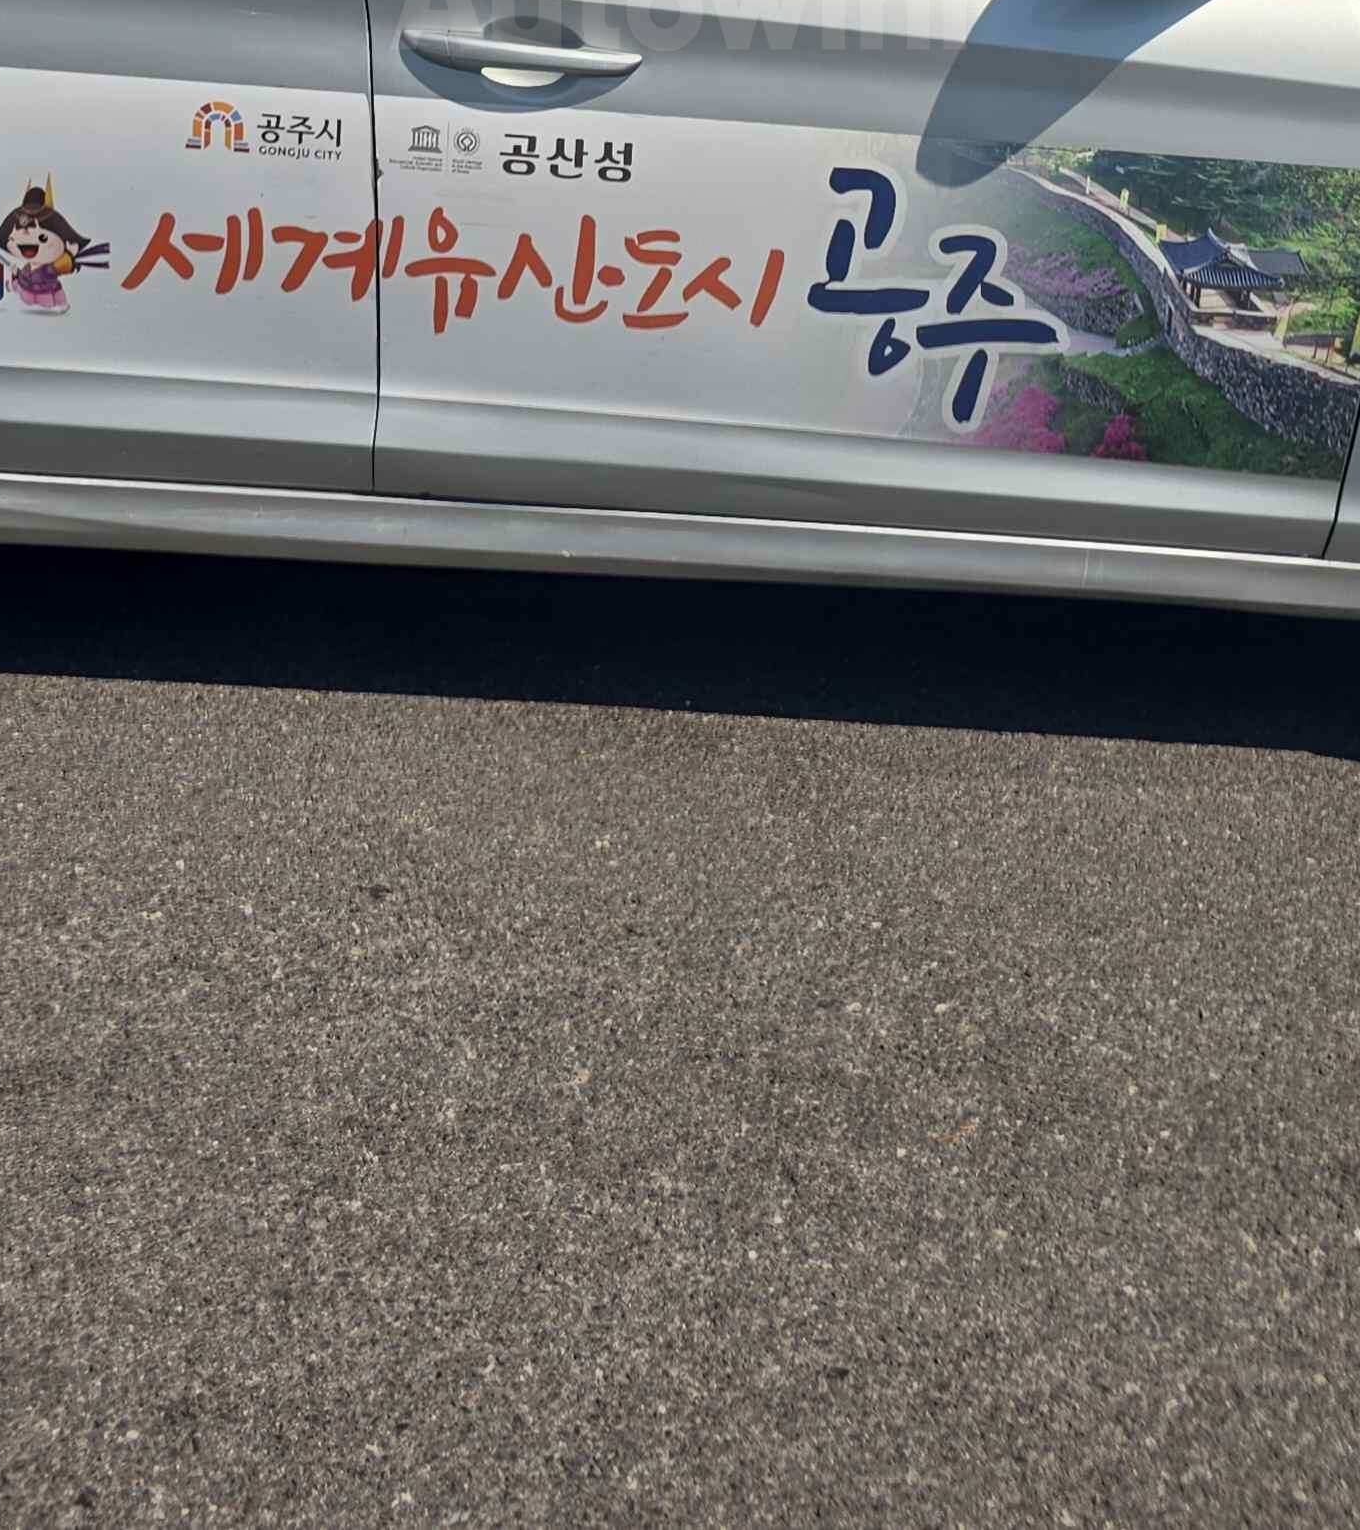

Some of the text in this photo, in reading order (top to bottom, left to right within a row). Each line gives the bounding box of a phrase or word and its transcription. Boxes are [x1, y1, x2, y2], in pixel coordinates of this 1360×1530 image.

[256, 113, 342, 148] 공주시
[258, 145, 342, 161] GONGJU CITY
[498, 133, 635, 184] 공산성
[120, 167, 1060, 425] 세계유산도시 공주
